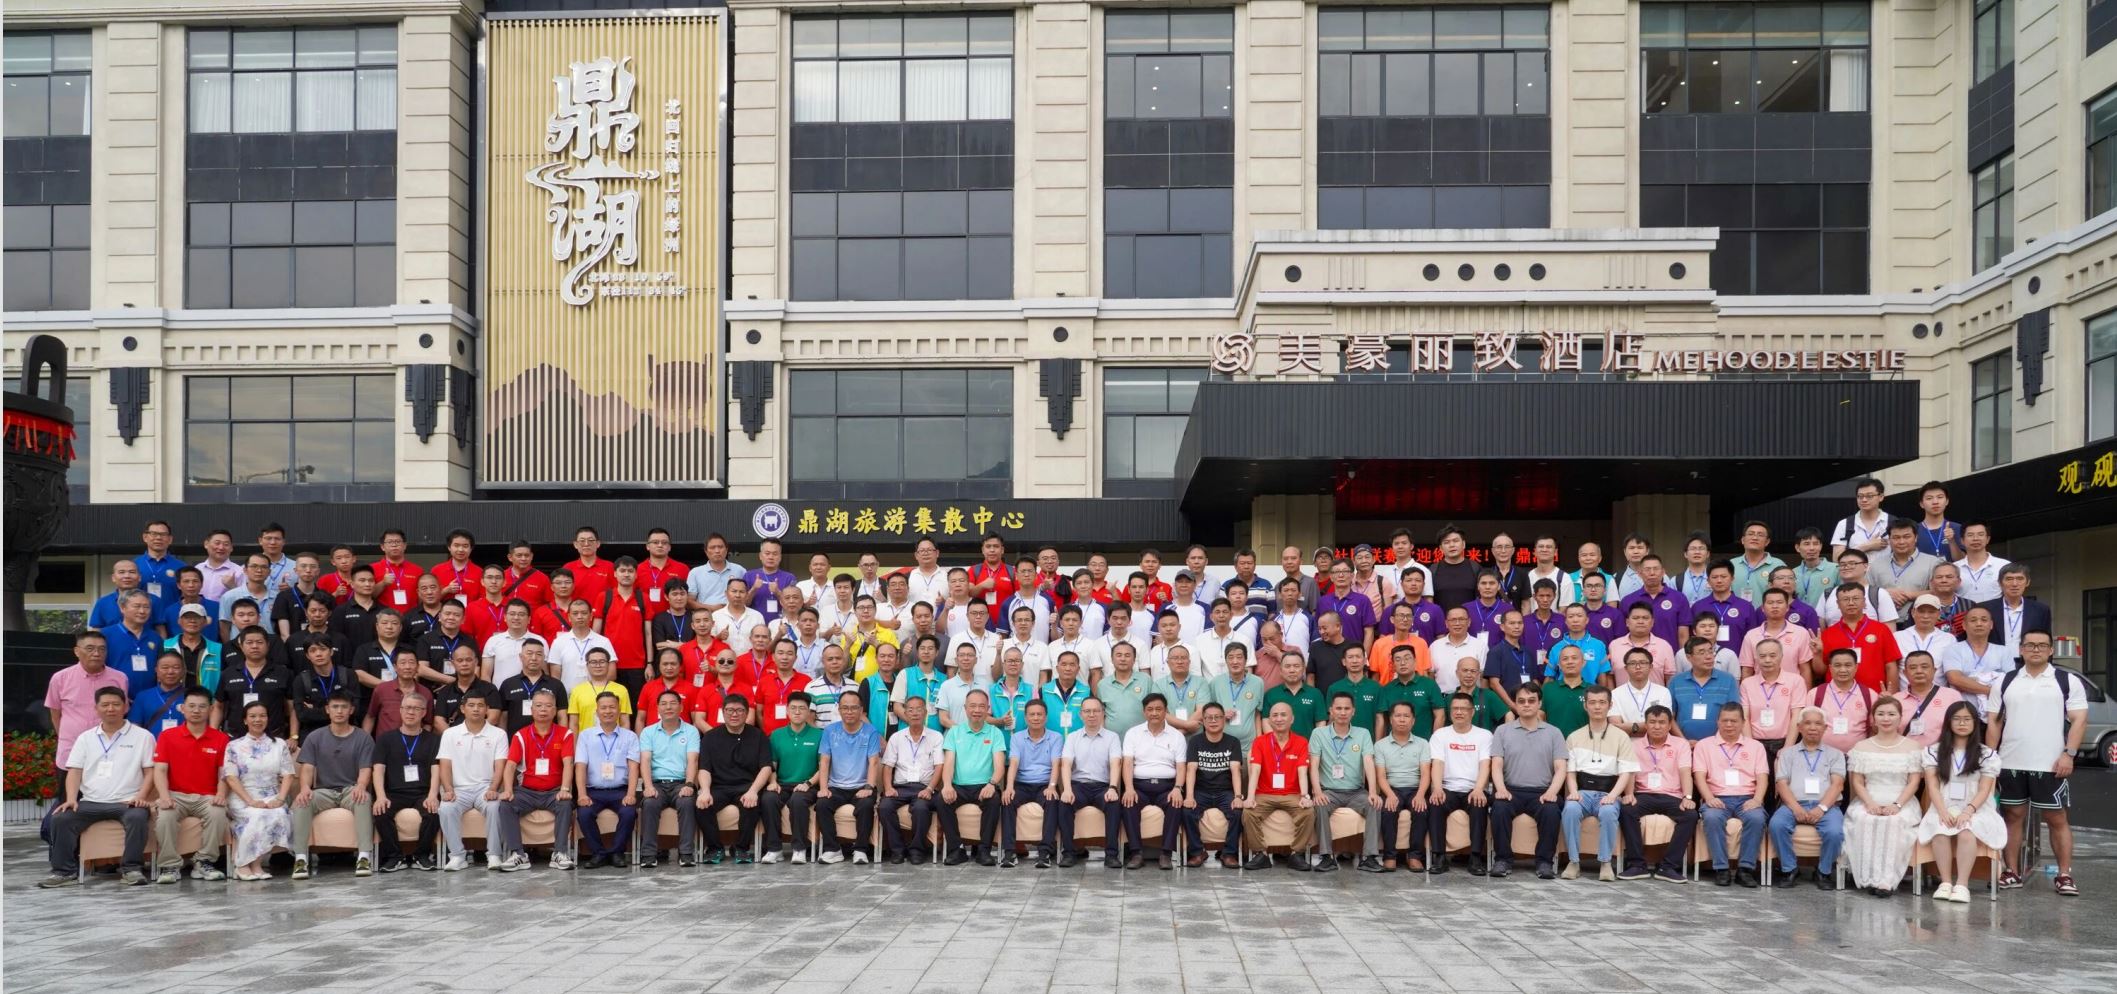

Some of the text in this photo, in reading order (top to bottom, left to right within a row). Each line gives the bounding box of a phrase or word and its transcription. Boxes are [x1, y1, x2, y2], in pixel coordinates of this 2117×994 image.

[526, 56, 660, 306] 鼎湖
[1277, 330, 1645, 374] 美豪丽致酒店
[2057, 451, 2117, 494] 观砚
[798, 506, 1025, 536] 鼎湖旅游集散中心
